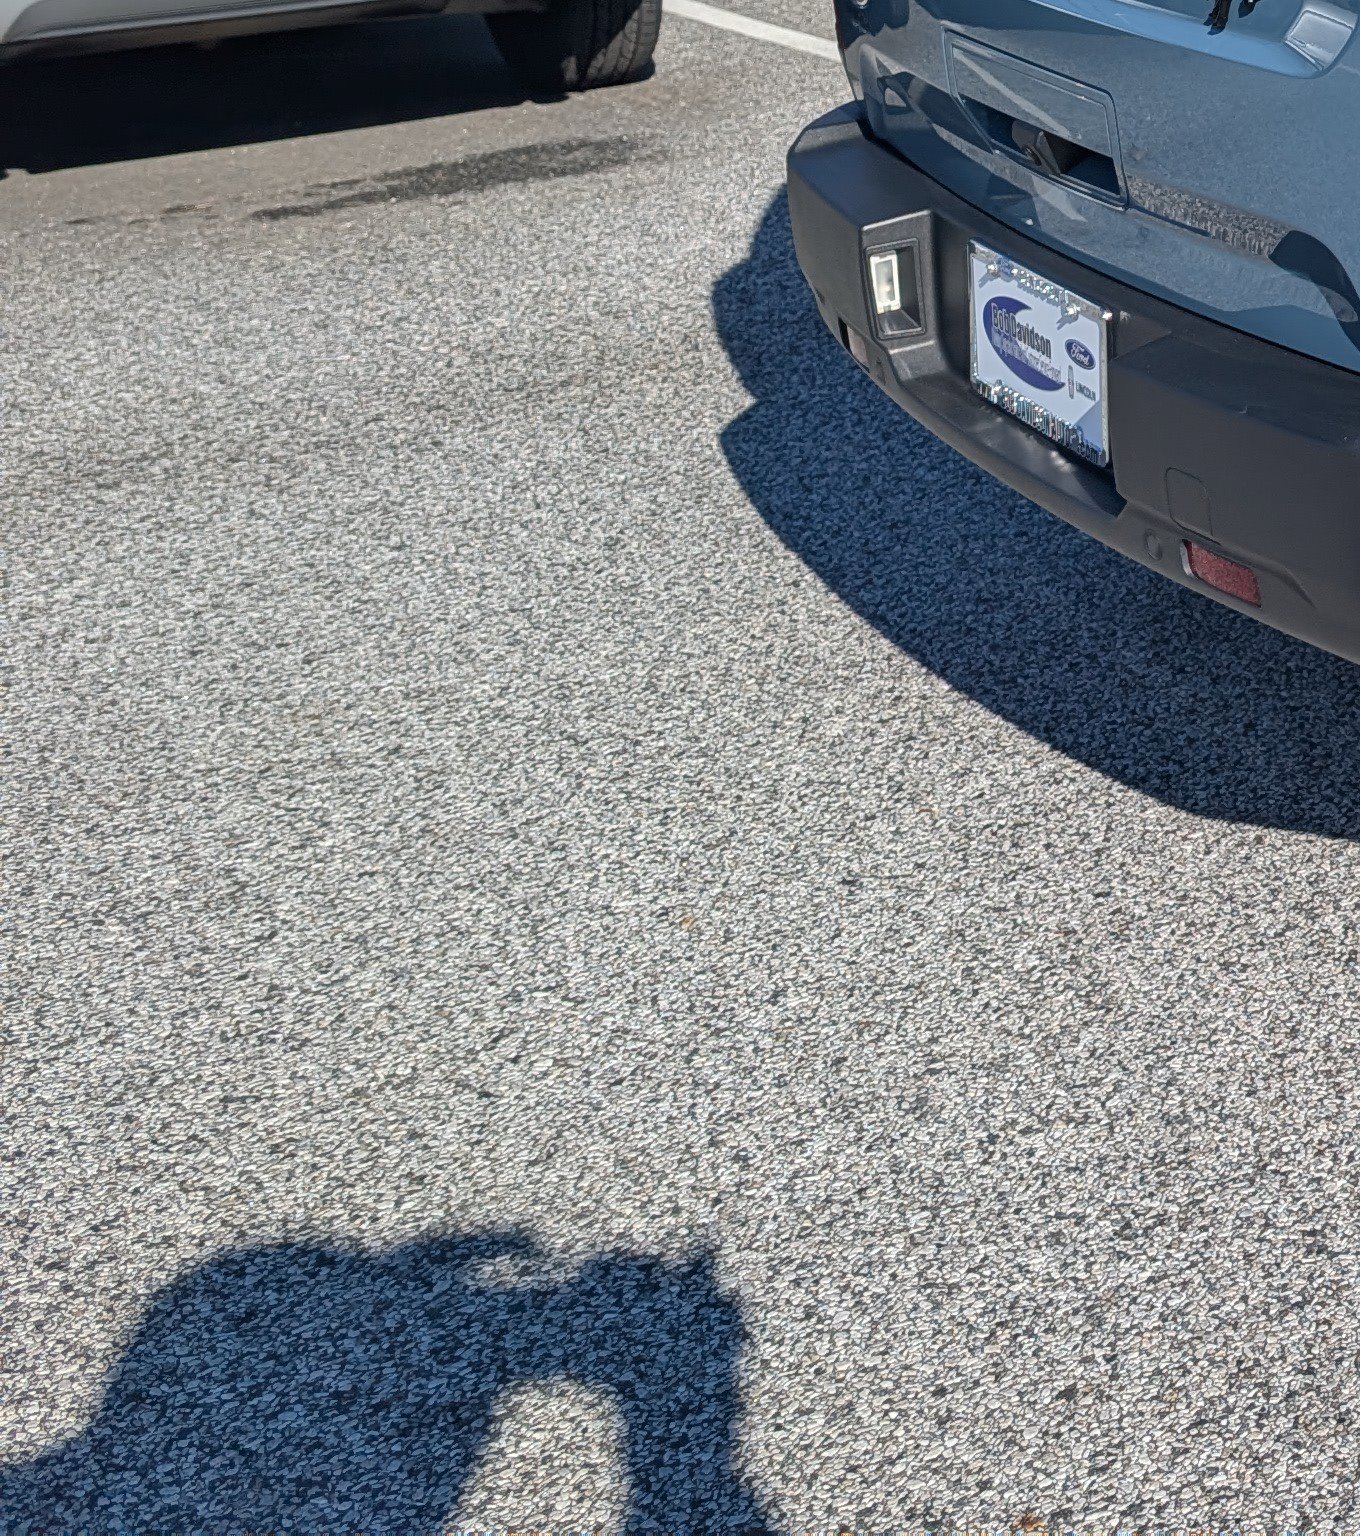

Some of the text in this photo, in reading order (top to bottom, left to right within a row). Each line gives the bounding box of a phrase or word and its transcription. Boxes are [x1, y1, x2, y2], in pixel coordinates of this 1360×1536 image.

[990, 302, 1011, 336] Bob
[1010, 312, 1052, 359] Davidson
[1069, 341, 1093, 367] Ford
[1075, 380, 1097, 402] LINCOLN
